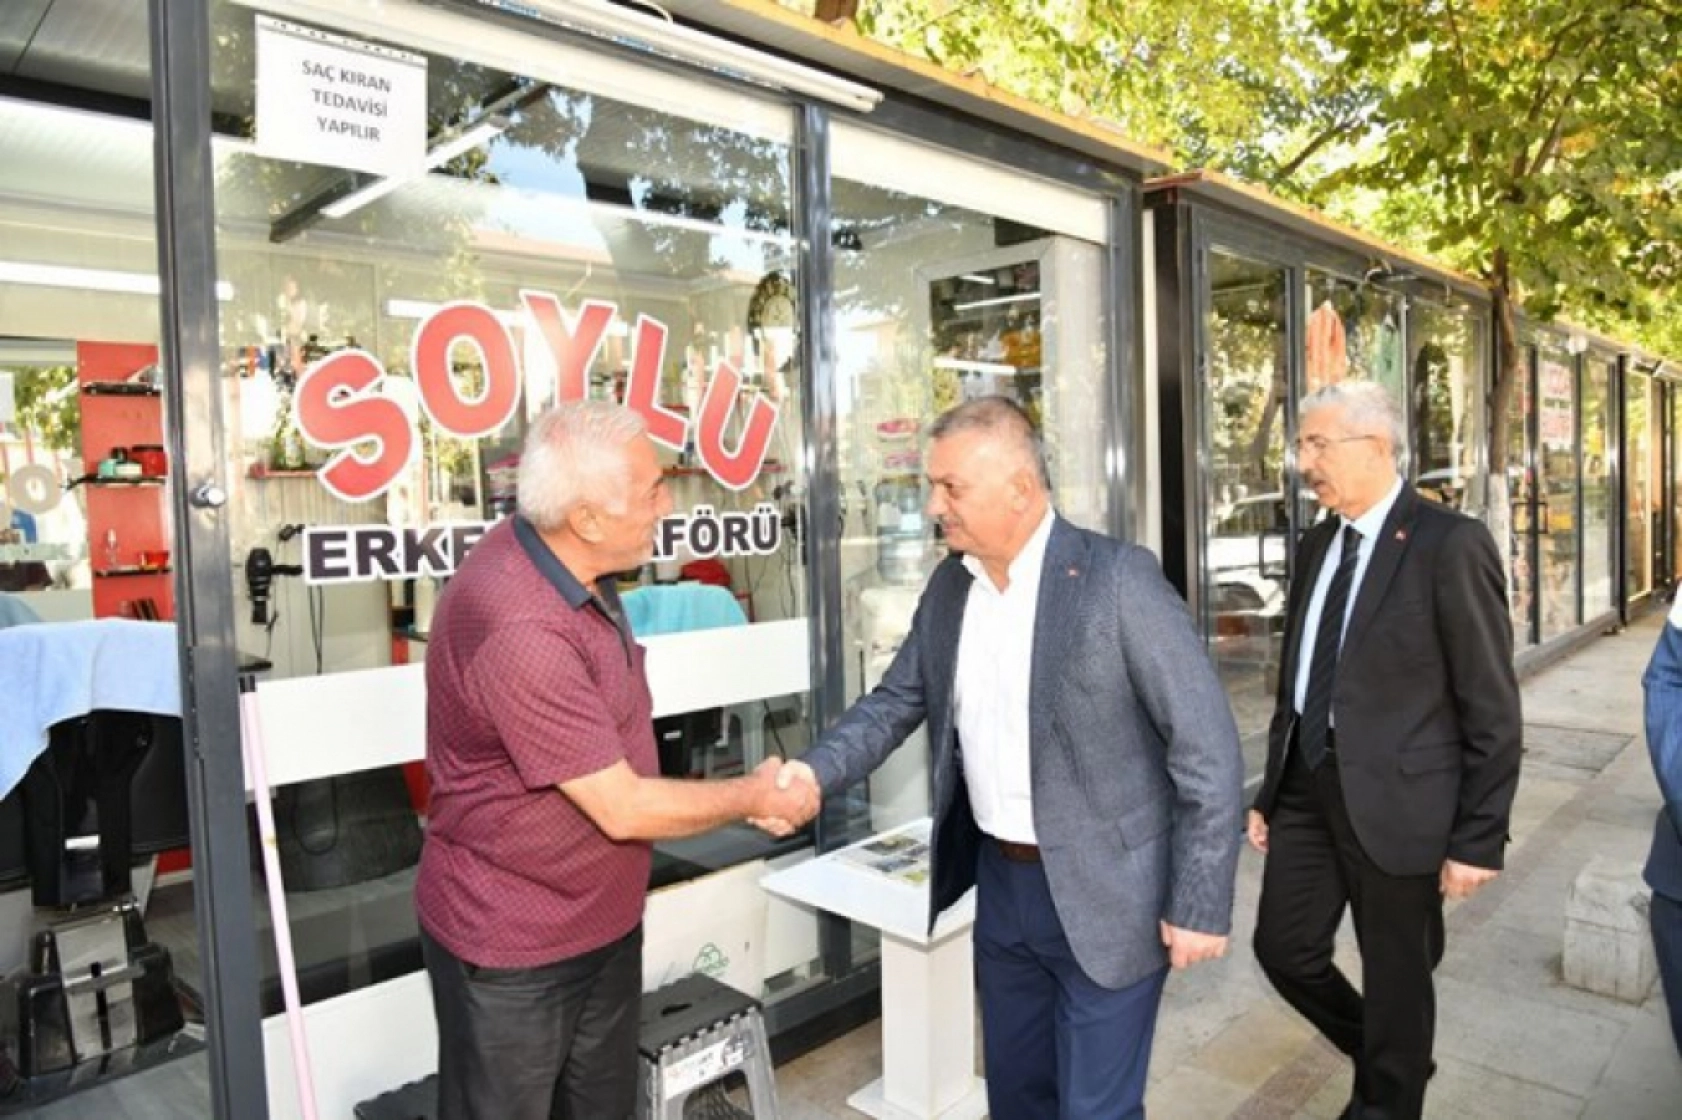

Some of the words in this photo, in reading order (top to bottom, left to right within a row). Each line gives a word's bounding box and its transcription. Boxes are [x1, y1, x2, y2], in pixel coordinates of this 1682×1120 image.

[302, 60, 335, 83] SAÇ
[341, 67, 392, 92] KIRAN
[311, 88, 388, 117] TEDAVİSİ
[317, 116, 380, 141] YAPILIR
[299, 292, 777, 499] SOYLU
